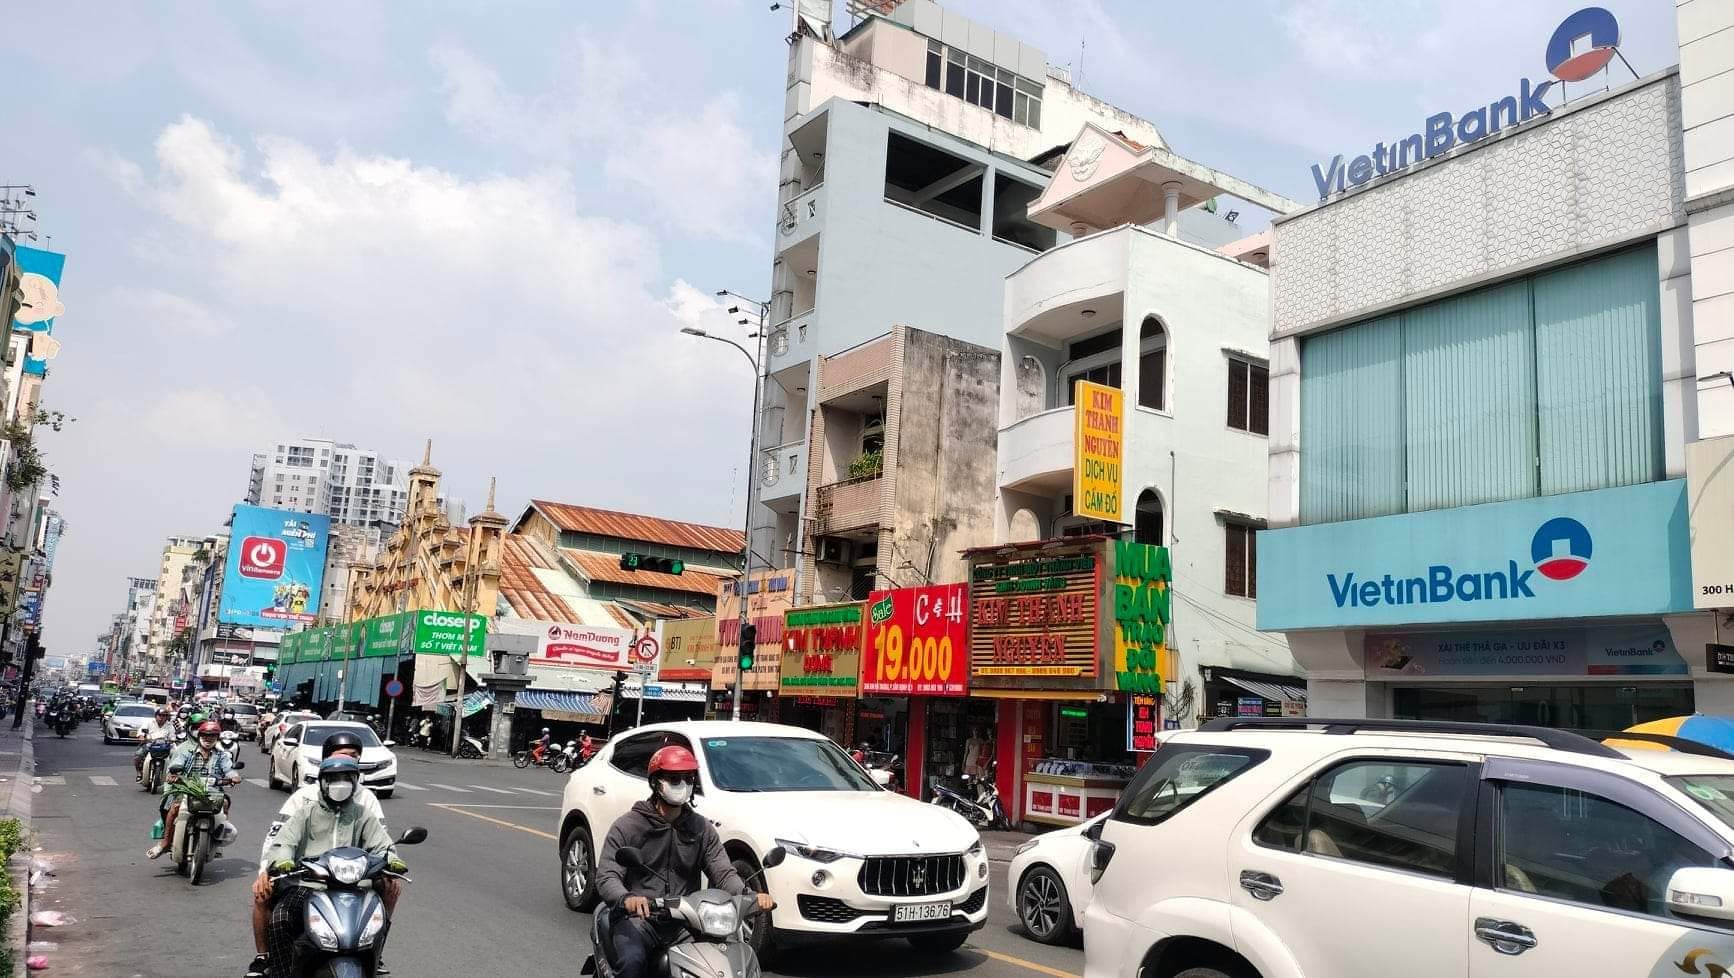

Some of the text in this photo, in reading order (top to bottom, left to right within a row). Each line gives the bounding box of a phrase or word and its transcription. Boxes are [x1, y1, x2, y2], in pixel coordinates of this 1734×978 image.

[1311, 78, 1552, 199] VietinBank
[1093, 390, 1112, 412] KIM
[1085, 458, 1118, 488] DỊCH VỤ
[1115, 541, 1171, 580] MUA
[1327, 560, 1536, 607] VietinBank
[1702, 586, 1722, 595] 300
[917, 594, 929, 626] C
[1115, 577, 1170, 624] BÁN
[423, 612, 481, 632] closep
[875, 624, 953, 681] 19.000
[1605, 647, 1653, 656] VietinBank
